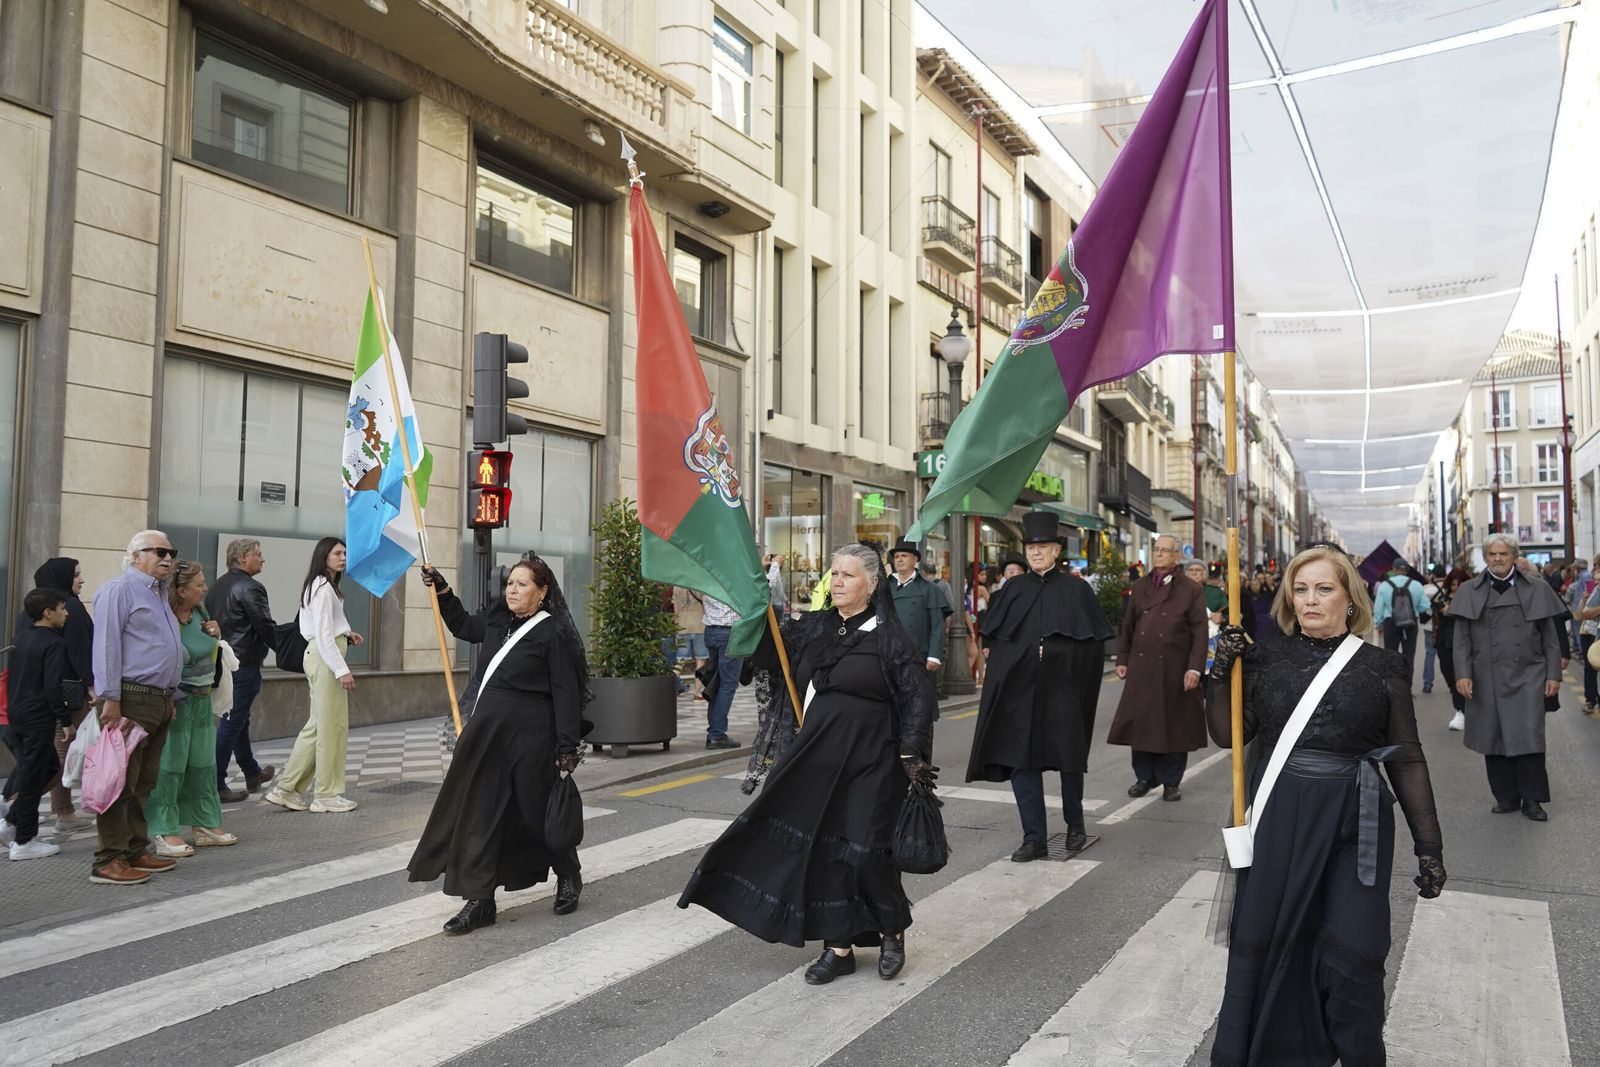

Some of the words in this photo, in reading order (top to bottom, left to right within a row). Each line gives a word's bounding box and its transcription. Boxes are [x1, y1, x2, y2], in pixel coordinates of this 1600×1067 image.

[923, 453, 946, 474] 16
[1024, 470, 1064, 498] ACIA
[475, 493, 499, 523] 30
